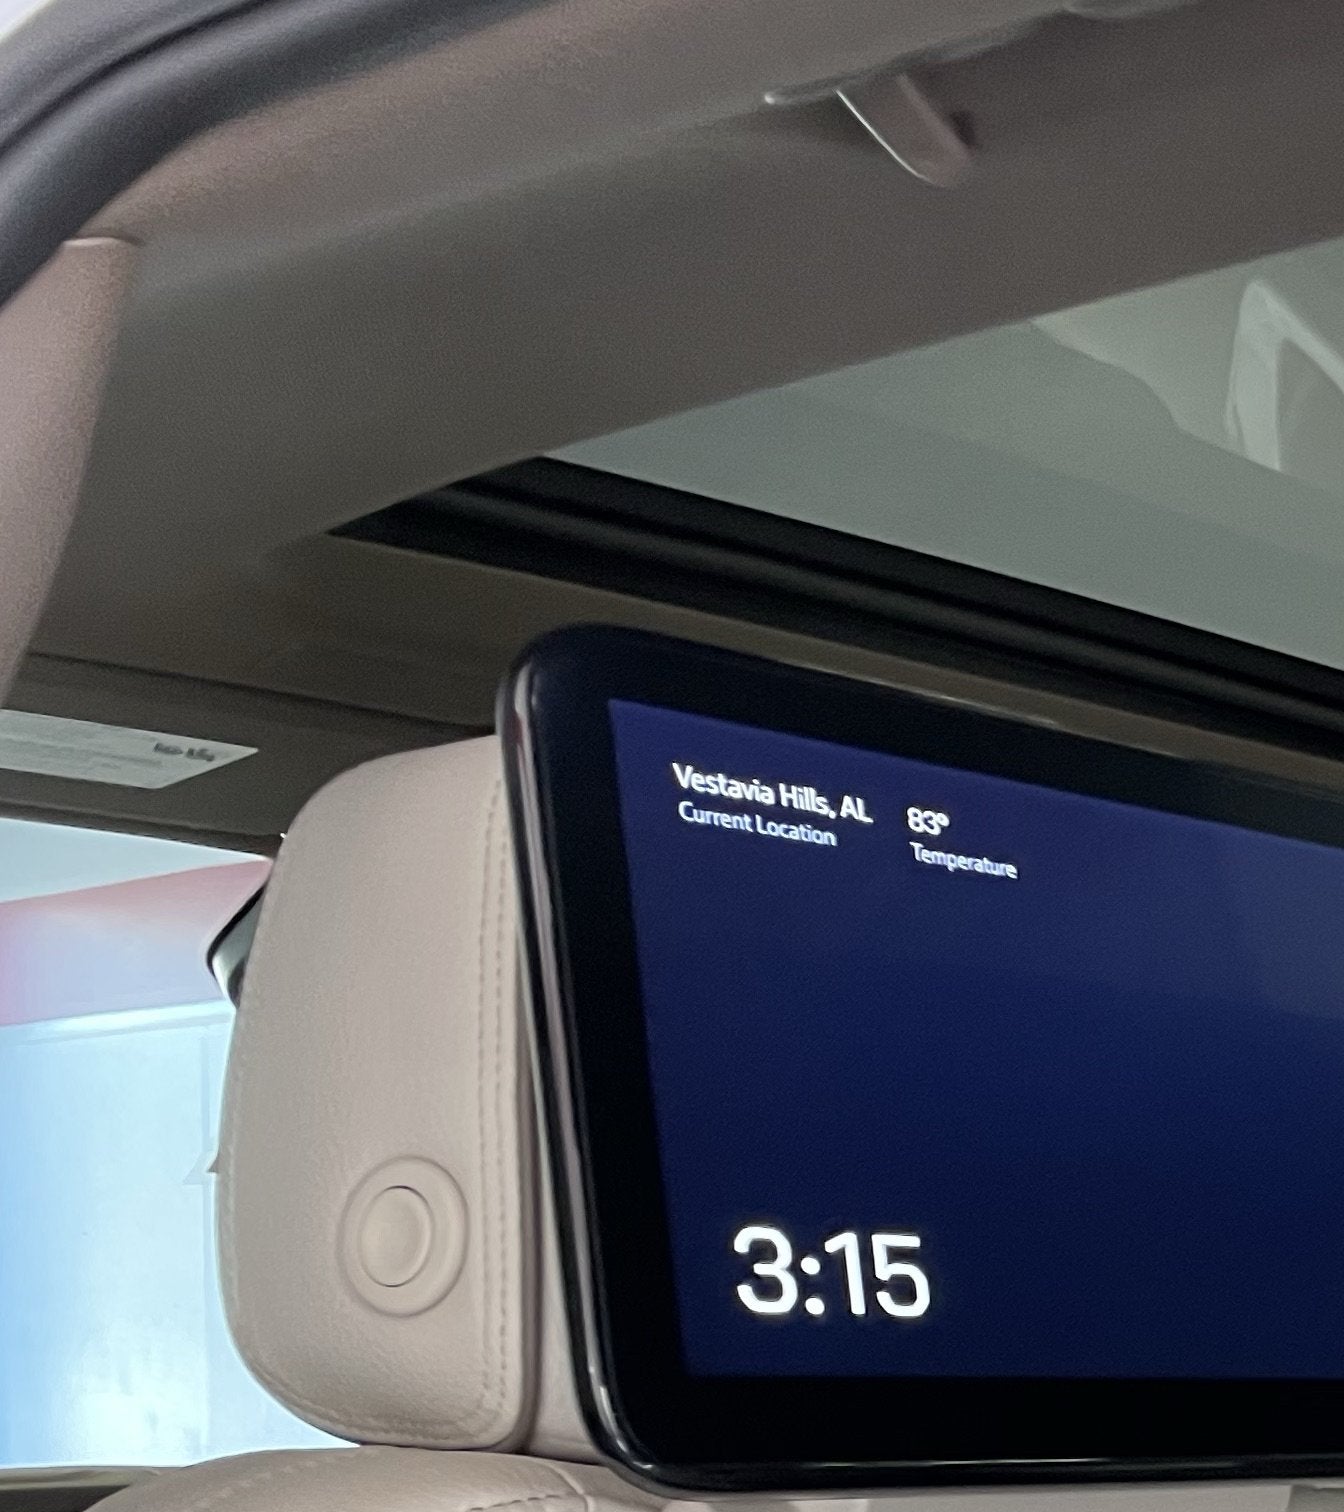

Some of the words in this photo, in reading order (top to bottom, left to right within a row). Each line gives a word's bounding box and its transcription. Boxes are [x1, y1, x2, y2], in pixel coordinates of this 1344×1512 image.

[671, 761, 776, 805] Vestavia
[778, 782, 837, 820] Hills,
[839, 795, 874, 824] AL
[677, 800, 753, 833] Current
[754, 814, 838, 847] Location
[908, 840, 1019, 880] Temperature
[733, 1225, 931, 1318] 3:15
